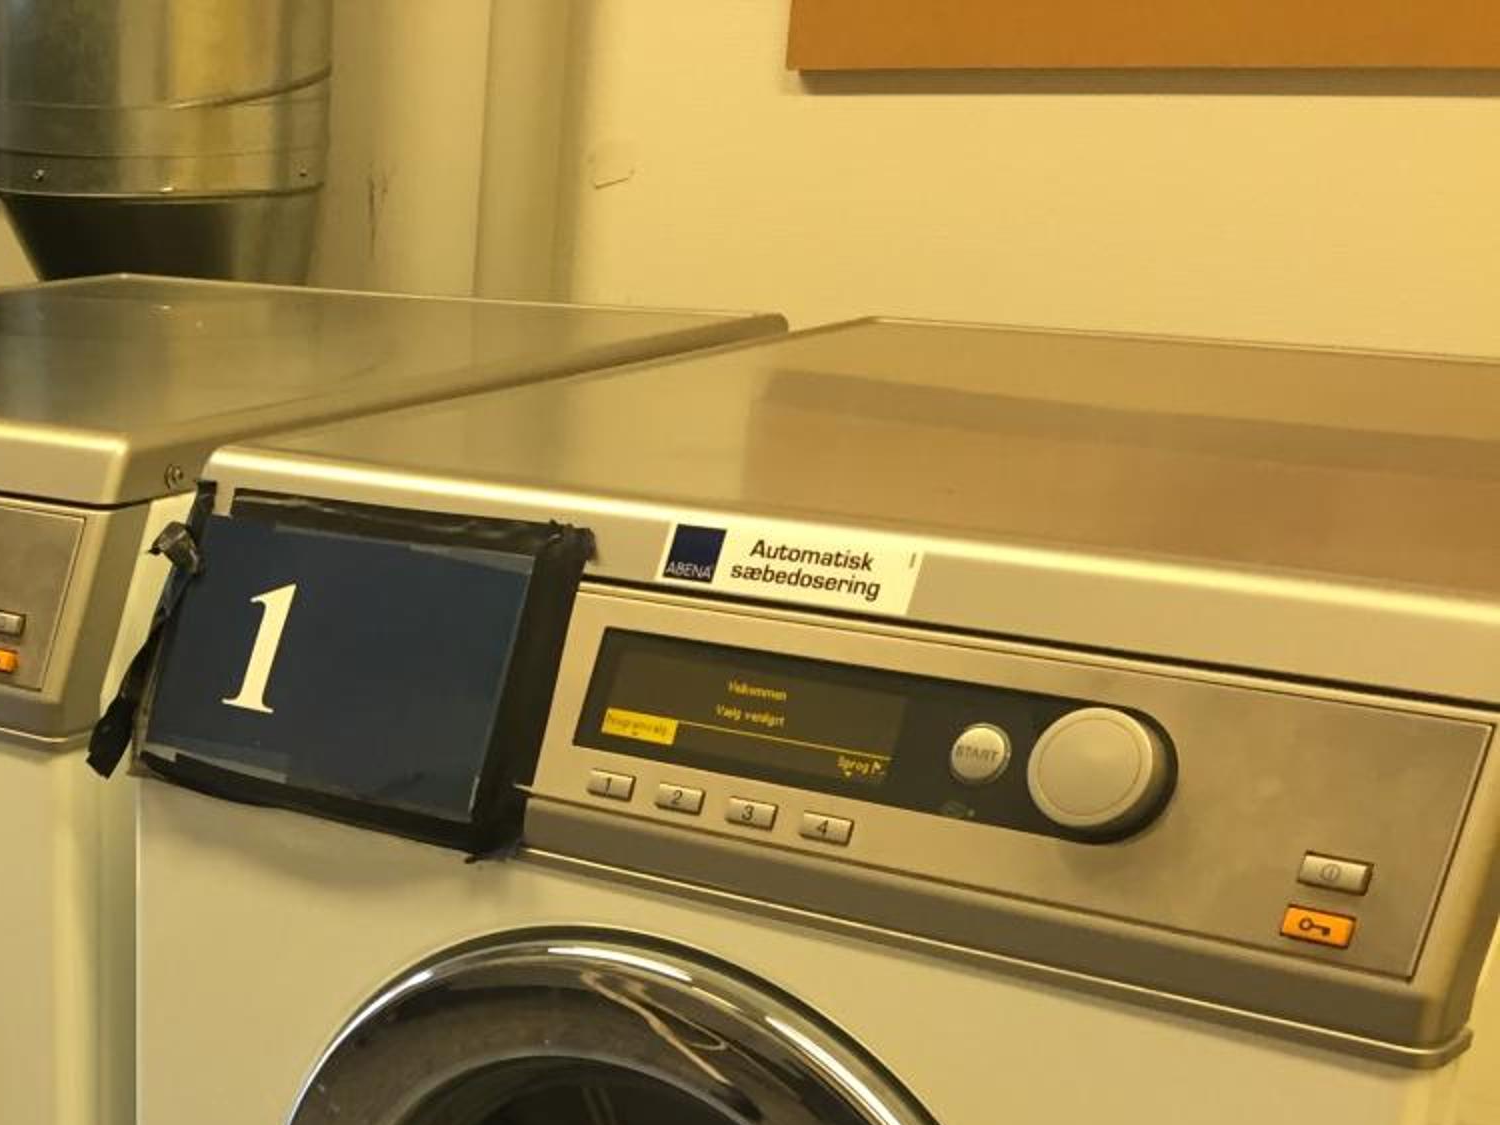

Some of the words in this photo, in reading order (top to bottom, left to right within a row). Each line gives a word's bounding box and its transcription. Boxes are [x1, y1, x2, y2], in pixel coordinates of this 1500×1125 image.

[749, 539, 875, 572] Automatisk
[664, 561, 713, 580] ABENA
[730, 562, 881, 602] sæbedosering
[221, 583, 297, 714] 1
[955, 744, 999, 762] START
[671, 789, 684, 806] 2
[741, 804, 754, 822] 3
[816, 819, 830, 837] 4
